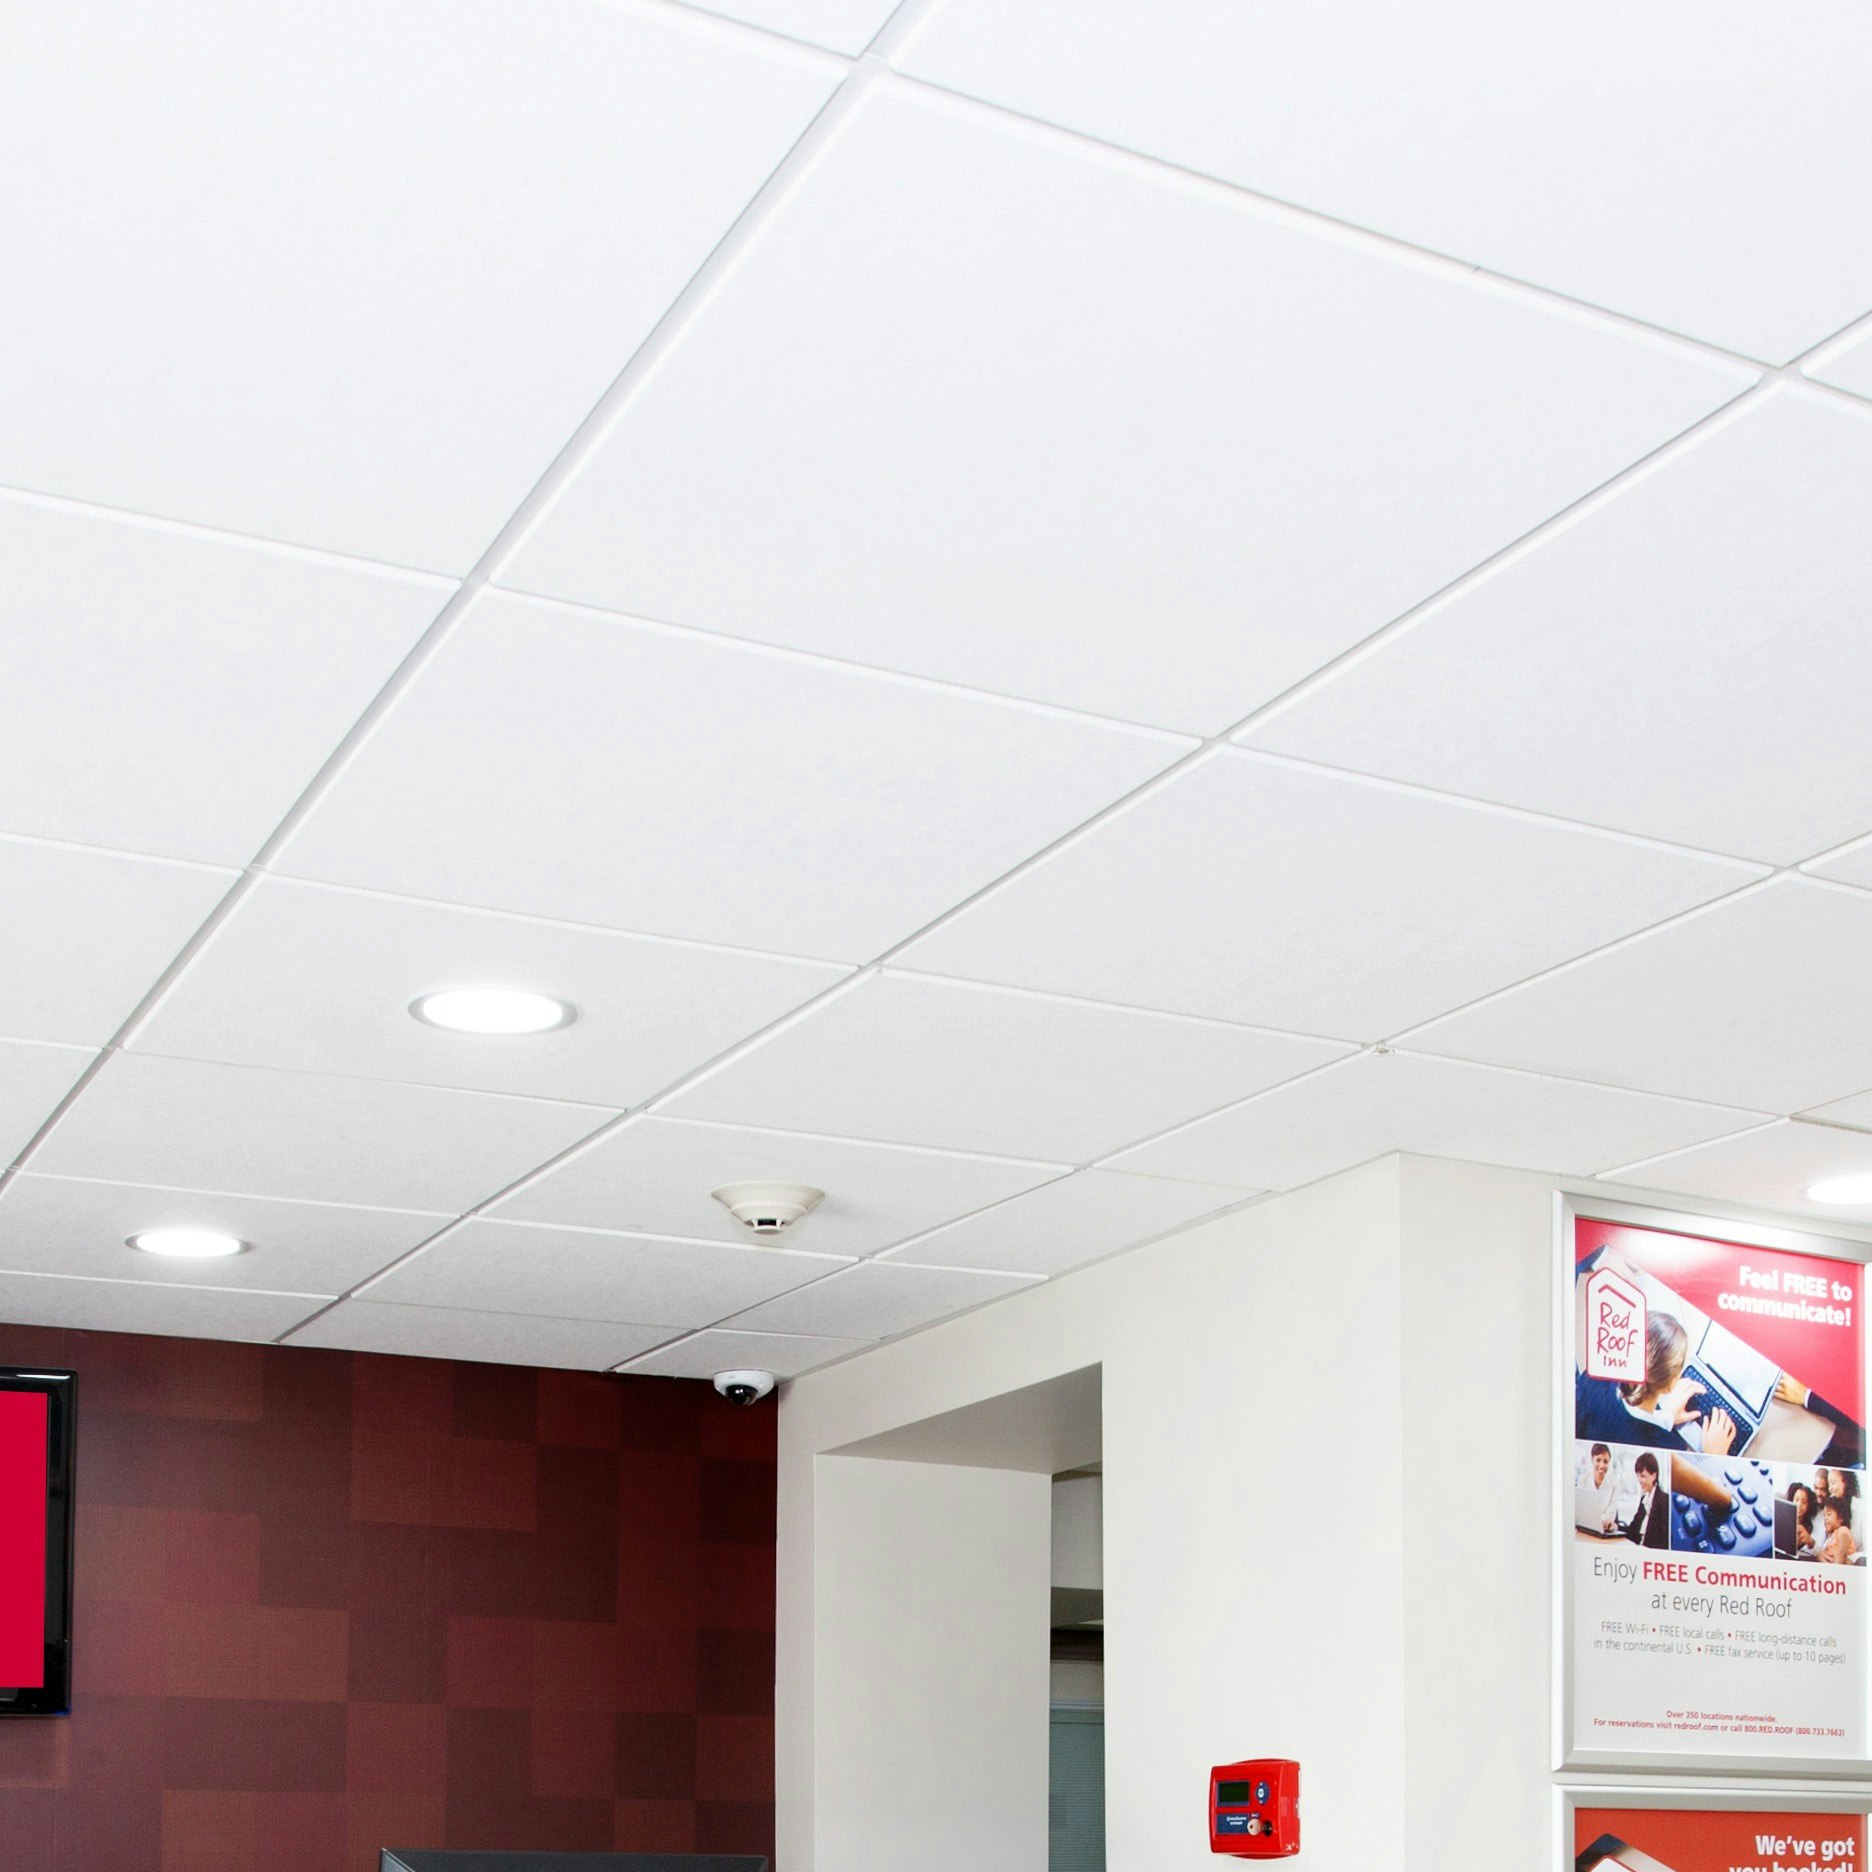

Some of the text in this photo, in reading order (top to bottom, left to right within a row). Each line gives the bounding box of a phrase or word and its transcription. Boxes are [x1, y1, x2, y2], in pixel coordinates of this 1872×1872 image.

[1740, 1267, 1853, 1302] Feel FREE to
[1599, 1302, 1630, 1328] Red
[1718, 1292, 1851, 1326] communicate!
[1597, 1328, 1638, 1357] Roof
[1594, 1558, 1846, 1595] Enjoy FREE Communication
[1652, 1593, 1792, 1618] at every Red Roof
[1601, 1622, 1837, 1648] FREE Wi-Fi FREE local calls FREE long-distance calls
[1594, 1639, 1603, 1649] in
[1606, 1639, 1620, 1650] the
[1623, 1640, 1674, 1653] continental
[1705, 1645, 1725, 1657] FREE
[1728, 1646, 1741, 1658] fax
[1744, 1648, 1773, 1659] service
[1776, 1648, 1789, 1662] (up
[1793, 1650, 1802, 1661] to
[1805, 1650, 1816, 1662] 10
[1818, 1652, 1846, 1666] pages)
[1594, 1718, 1606, 1727] For
[1608, 1719, 1654, 1729] reservations
[1657, 1721, 1672, 1730] visit
[1674, 1722, 1718, 1732] redroof.com
[1701, 1712, 1733, 1722] locations
[1756, 1835, 1854, 1861] We've got
